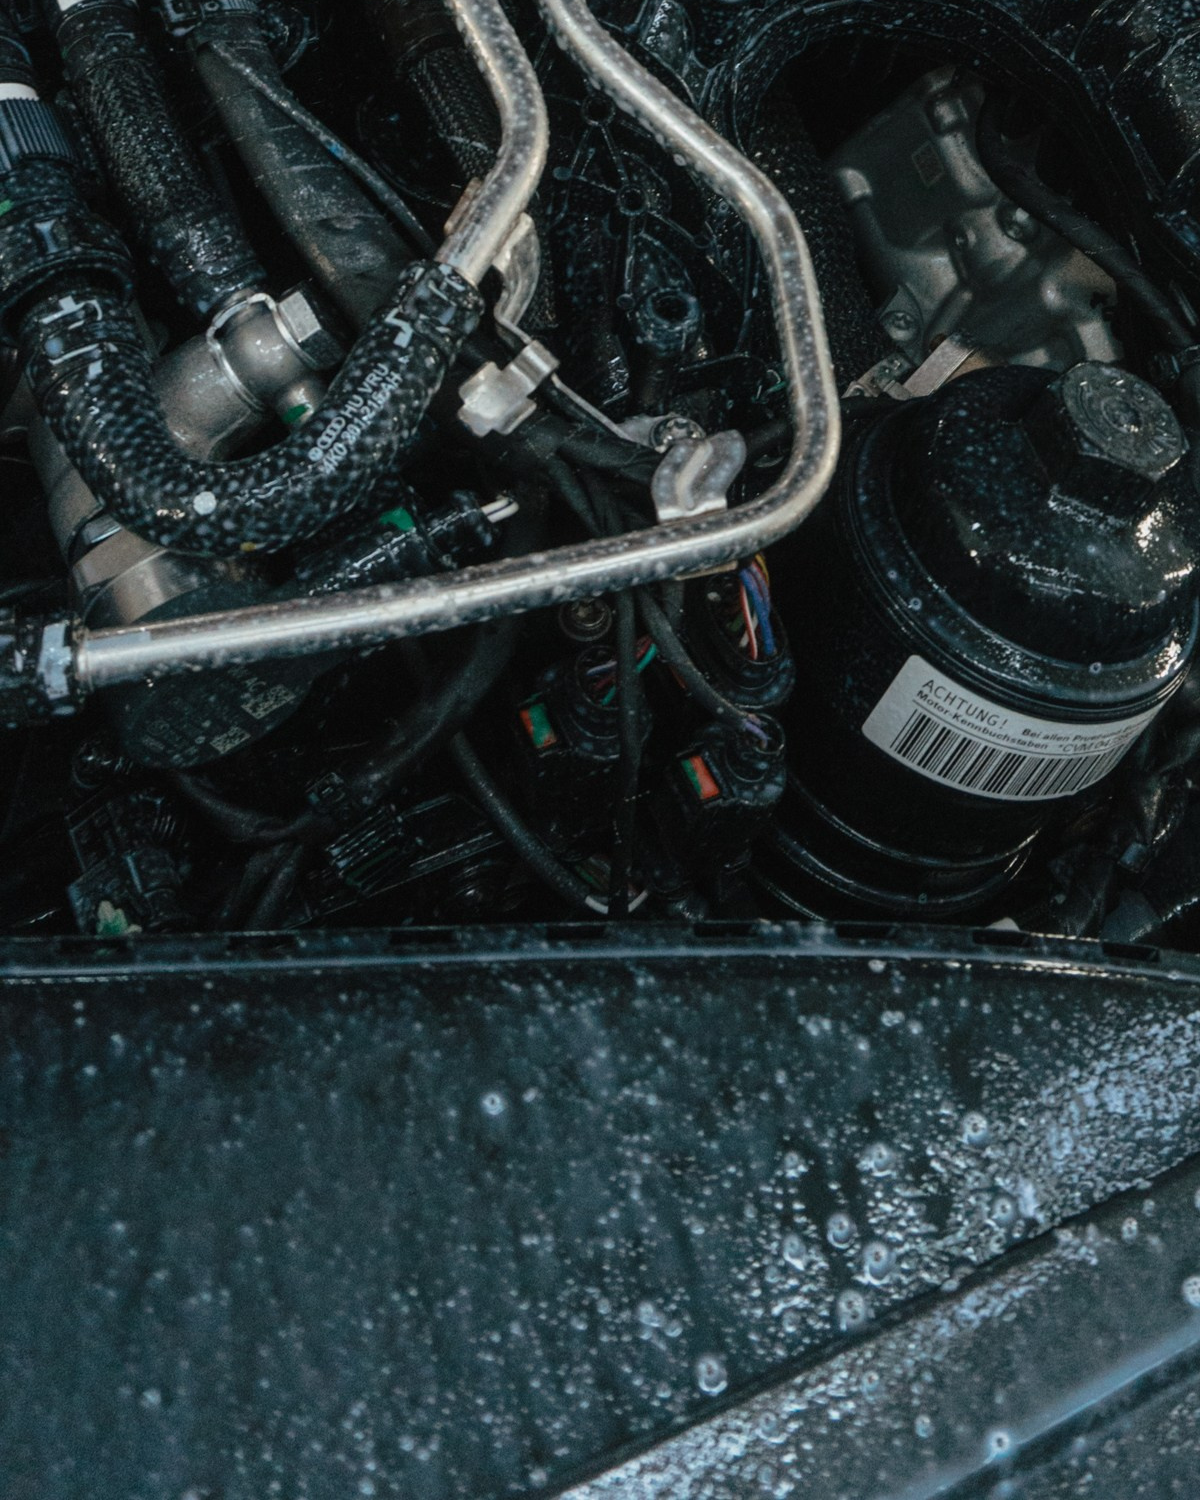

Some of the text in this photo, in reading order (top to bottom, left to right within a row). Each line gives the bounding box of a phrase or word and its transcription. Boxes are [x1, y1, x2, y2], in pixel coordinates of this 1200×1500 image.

[340, 362, 389, 419] HU VRU
[915, 690, 1049, 751] Motor-Kennbuchstaben
[1020, 727, 1041, 740] Bei
[1042, 731, 1070, 743] allen
